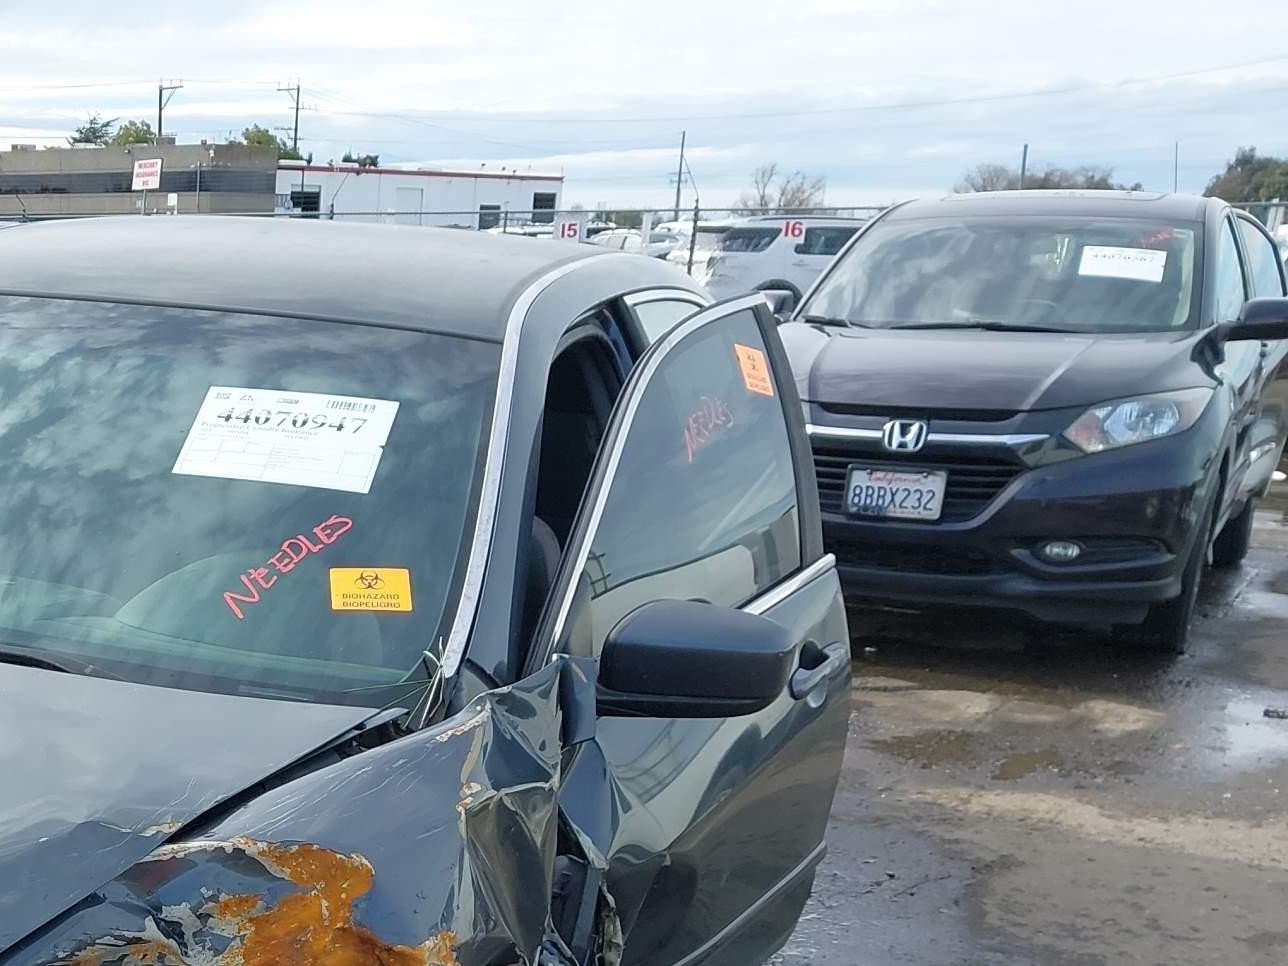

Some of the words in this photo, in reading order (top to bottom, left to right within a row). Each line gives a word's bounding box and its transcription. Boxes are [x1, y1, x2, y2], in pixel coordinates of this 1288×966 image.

[561, 223, 578, 238] 15
[784, 221, 804, 238] 16
[217, 407, 368, 434] 44070947
[852, 484, 936, 511] 8BBX232
[223, 514, 353, 619] NEEDLES
[342, 592, 400, 600] BIOHAZARD
[342, 601, 401, 609] BIOPELIGRO
